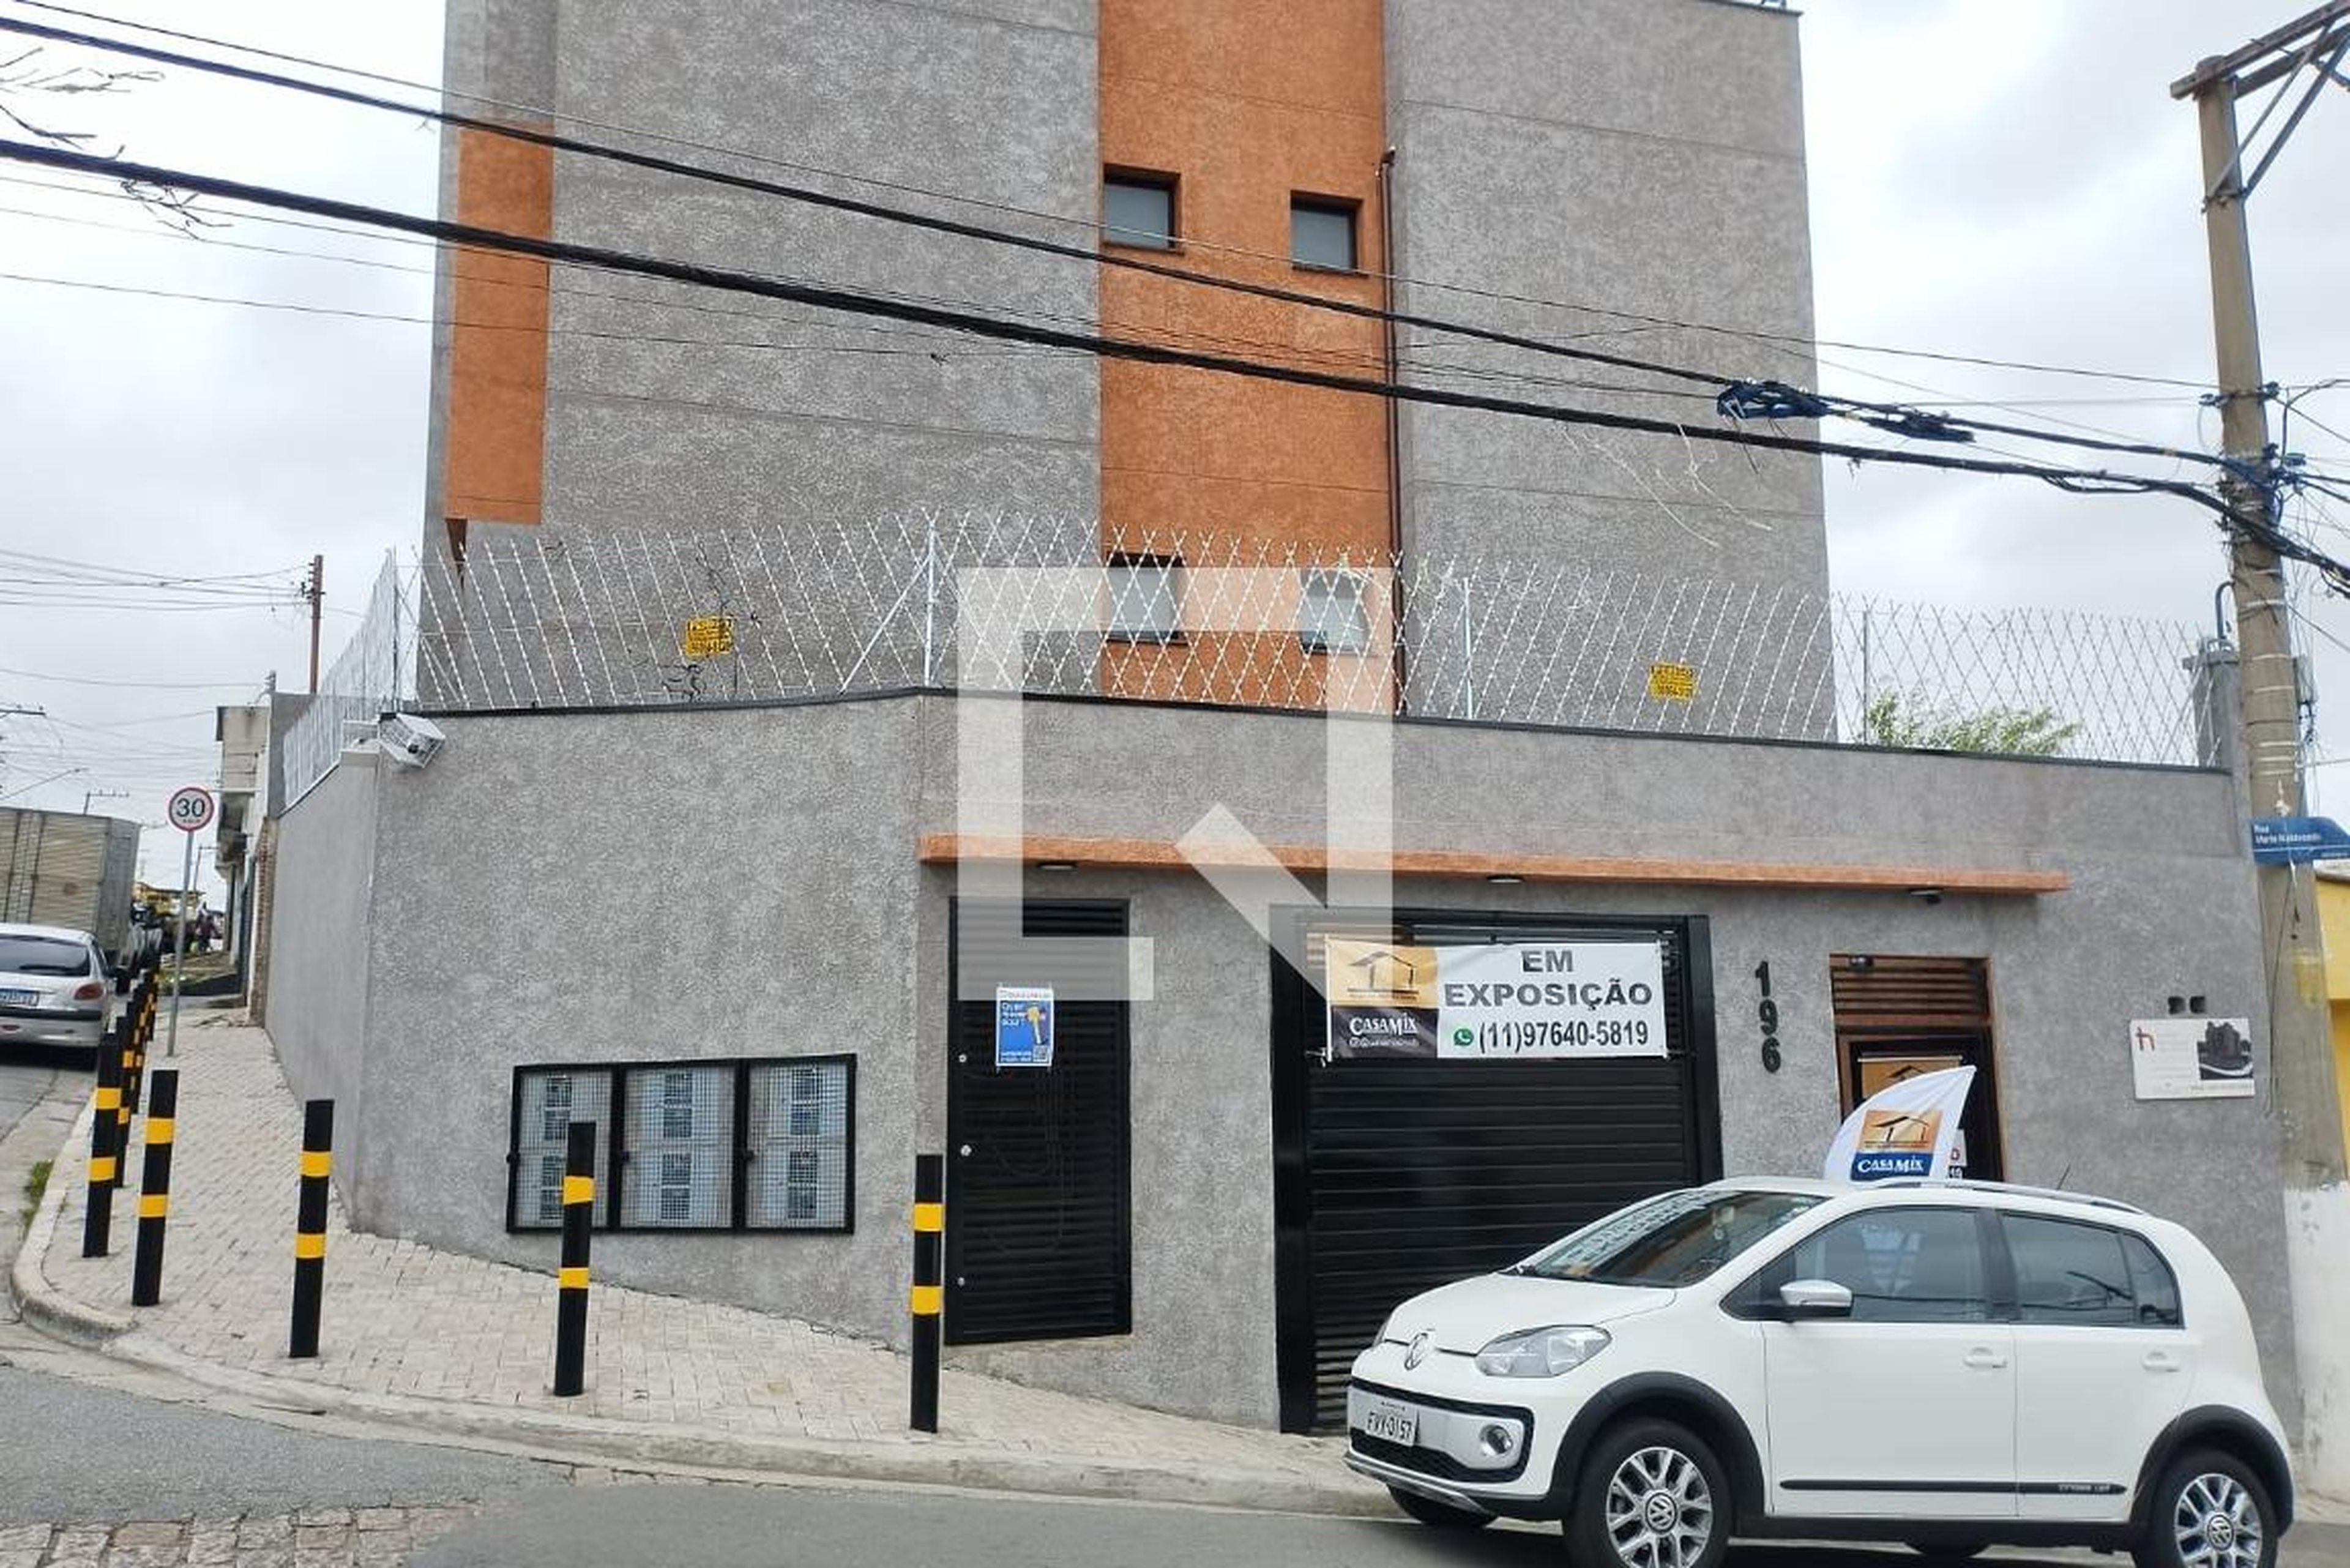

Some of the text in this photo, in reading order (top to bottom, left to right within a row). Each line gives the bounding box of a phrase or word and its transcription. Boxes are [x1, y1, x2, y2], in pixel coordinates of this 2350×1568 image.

[176, 797, 206, 818] 30
[1521, 950, 1574, 973] EM
[1444, 979, 1652, 1010] EXPOSIÇÃO
[1755, 961, 1781, 1073] 196
[1479, 1021, 1649, 1053] (11)97640-5819
